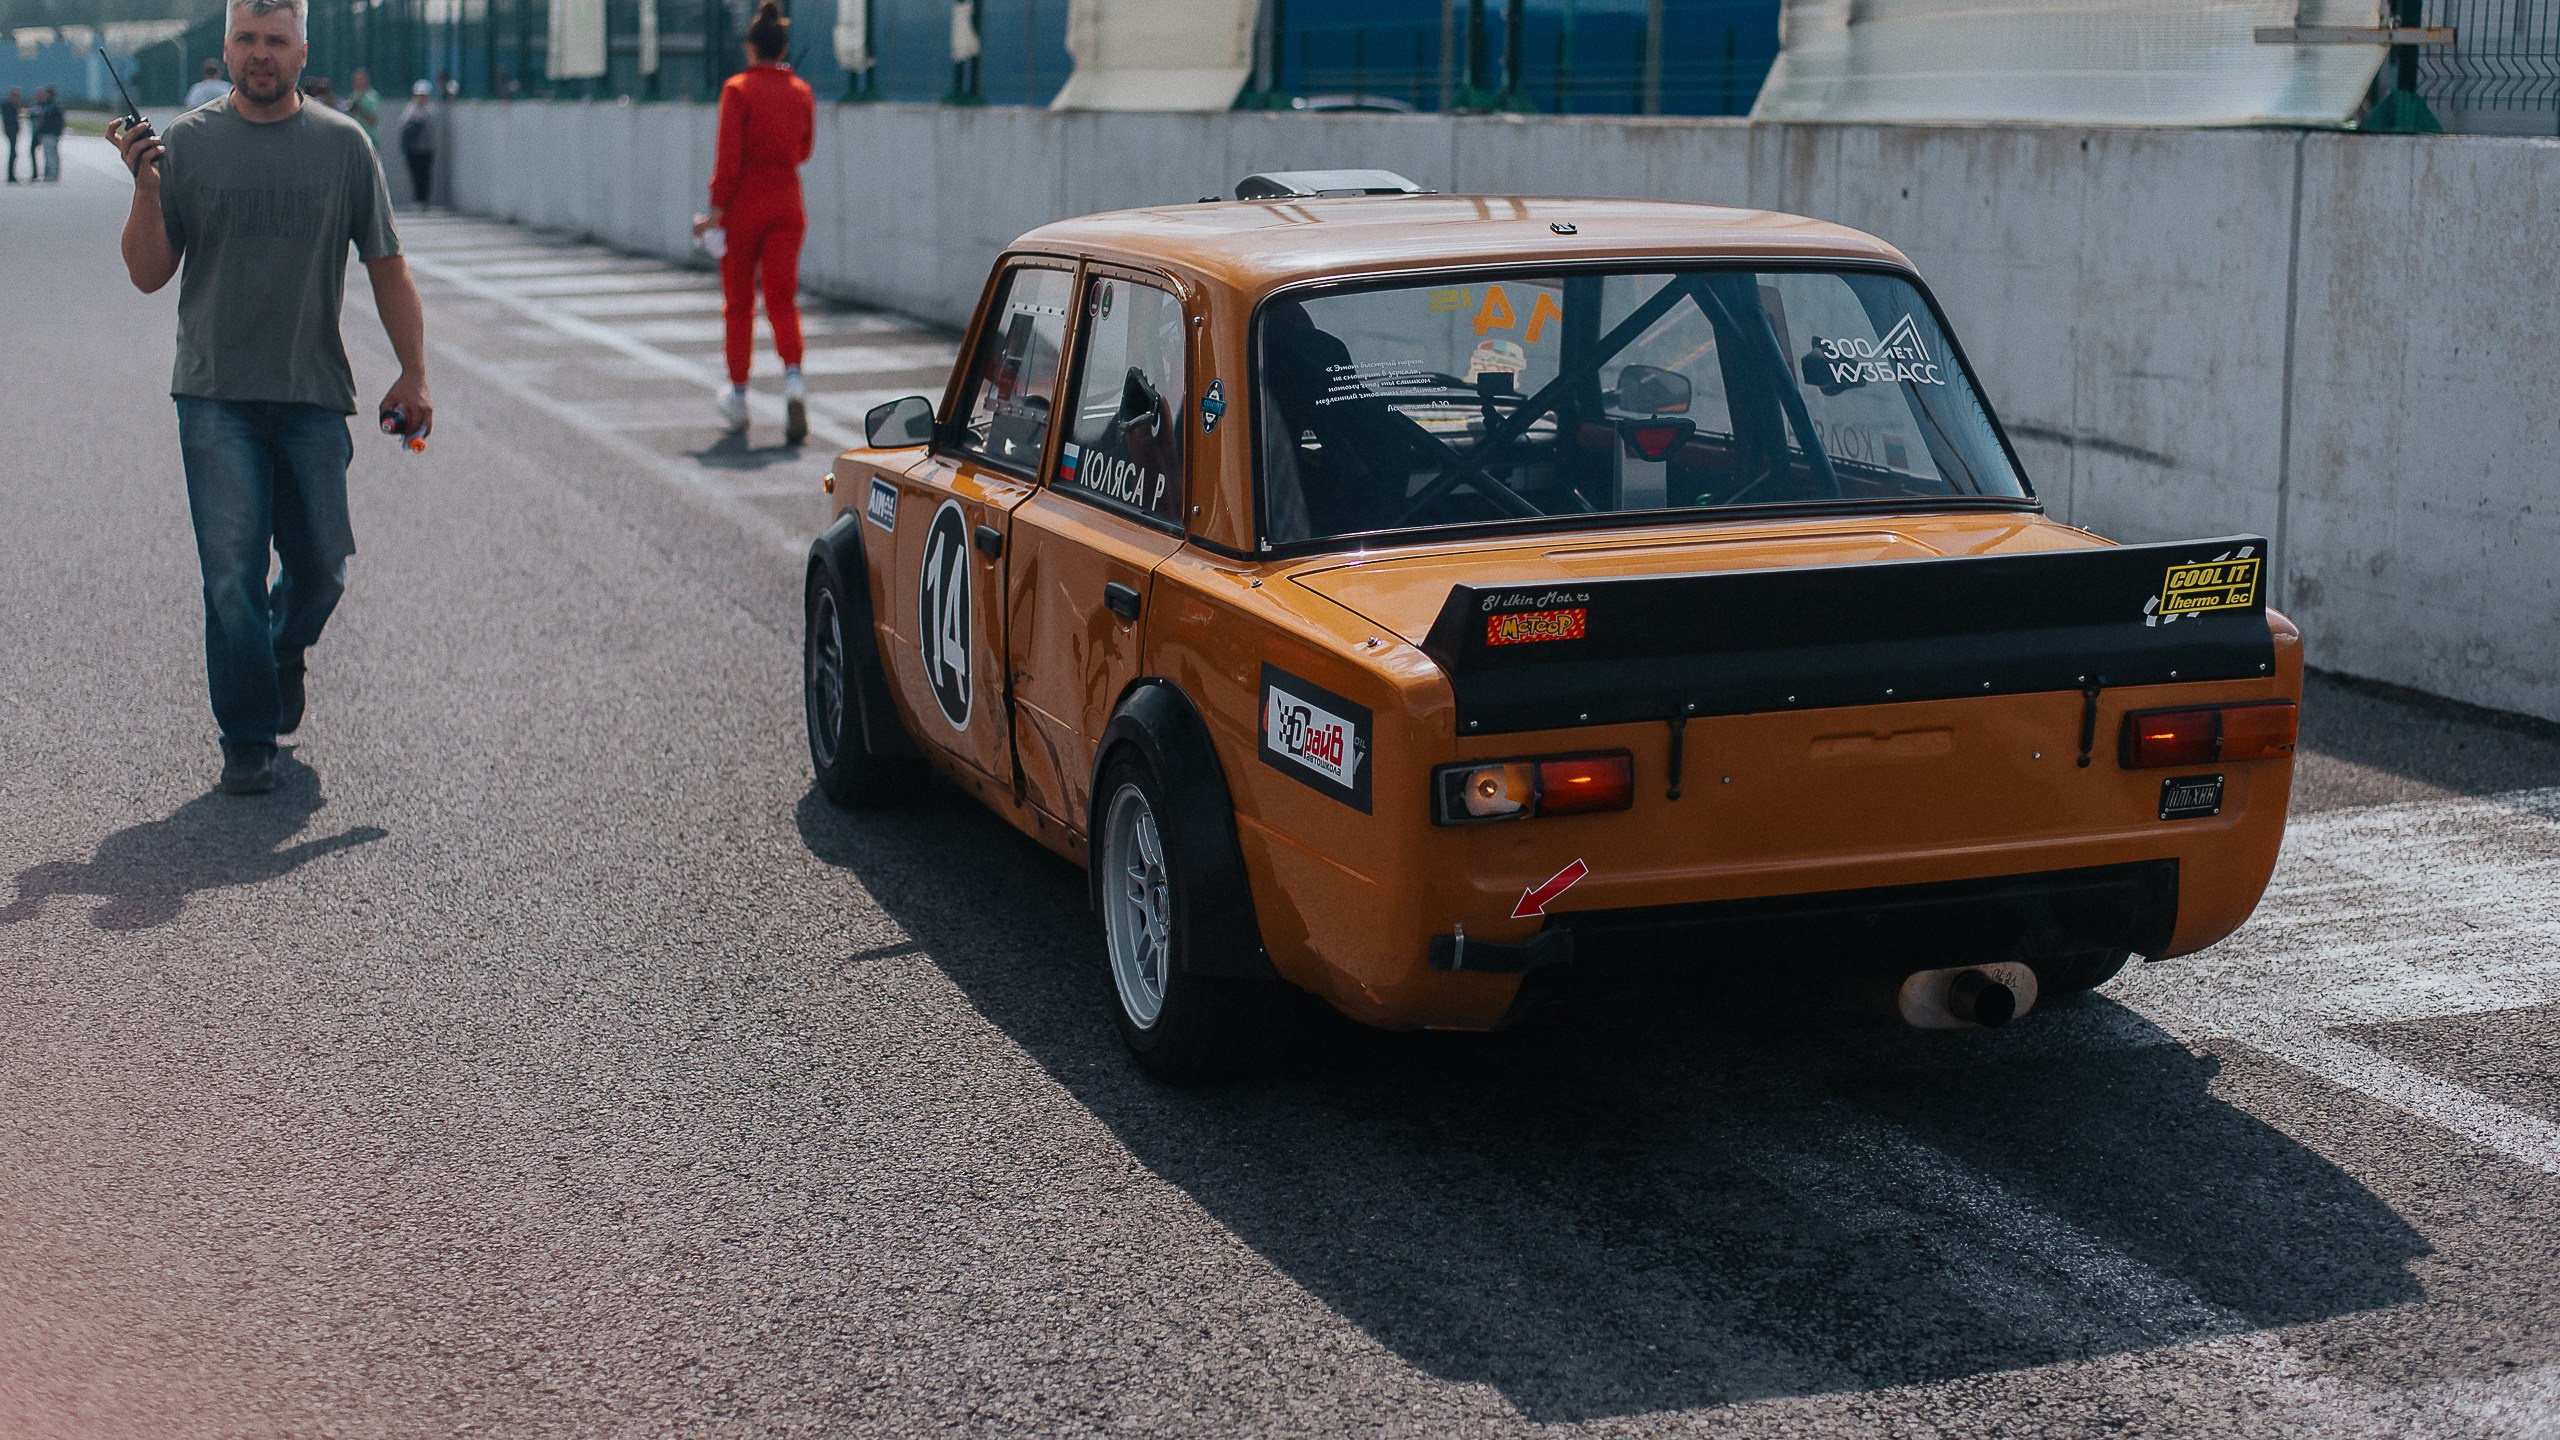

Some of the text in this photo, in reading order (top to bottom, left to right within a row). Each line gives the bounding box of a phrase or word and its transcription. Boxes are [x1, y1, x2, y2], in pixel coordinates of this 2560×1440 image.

[1820, 338, 1874, 360] 300
[1828, 362, 1946, 386] КУЗБАСС
[1080, 448, 1145, 507] КОЛЯСА
[2169, 564, 2250, 589] COOL IT
[2167, 585, 2249, 610] Thermo Tec
[926, 531, 967, 704] 14
[1306, 752, 1342, 777] автошкола
